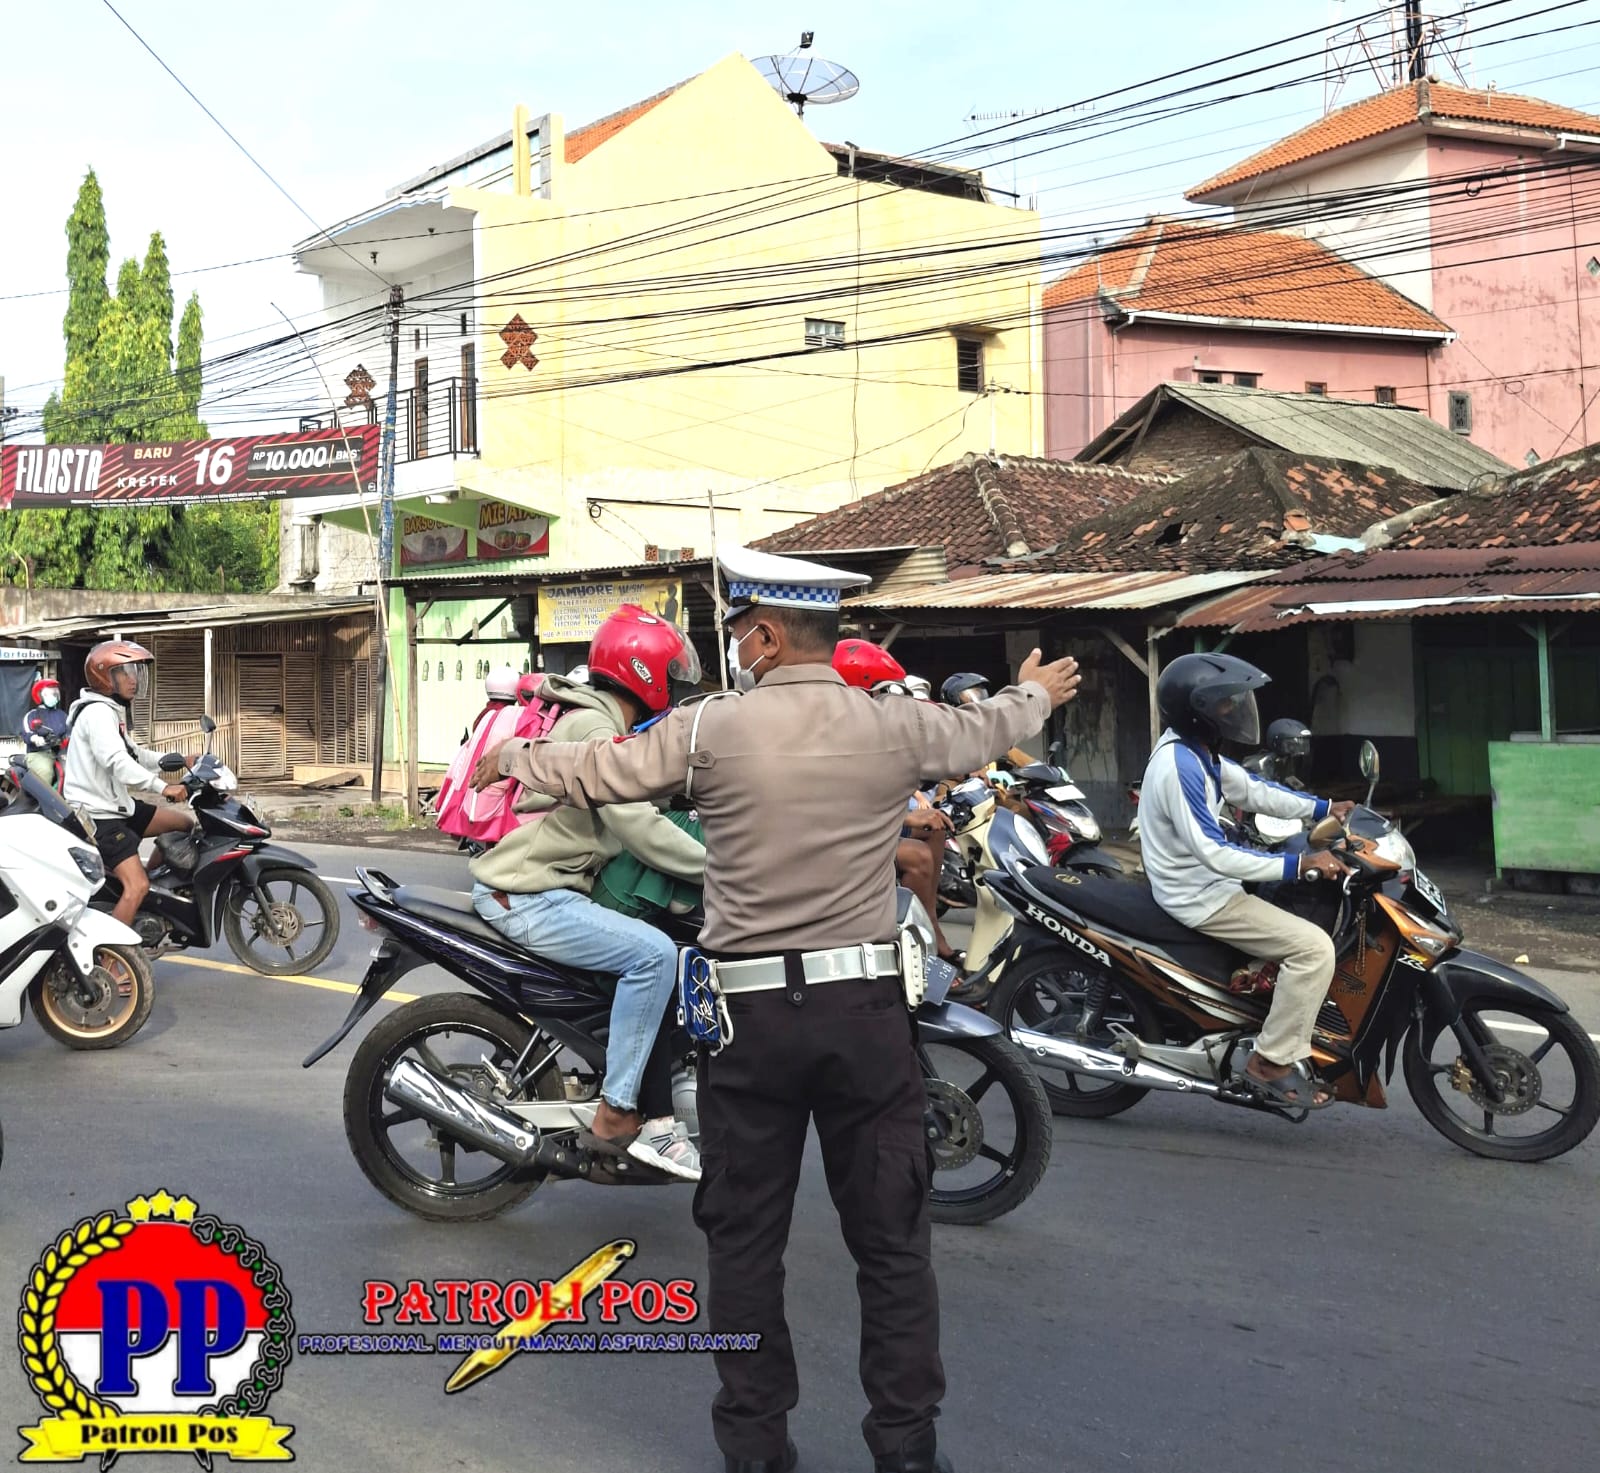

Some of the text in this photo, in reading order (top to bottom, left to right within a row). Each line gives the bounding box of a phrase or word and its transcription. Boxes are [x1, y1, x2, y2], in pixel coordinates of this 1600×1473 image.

[134, 446, 173, 460] BARU
[193, 444, 236, 487] 16
[252, 451, 266, 462] RP
[264, 446, 328, 471] 10.000
[15, 447, 104, 495] FILASTA
[116, 474, 179, 489] KRETEK
[479, 500, 505, 531] MIE
[0, 649, 49, 659] artabak
[1025, 902, 1112, 968] HONDA
